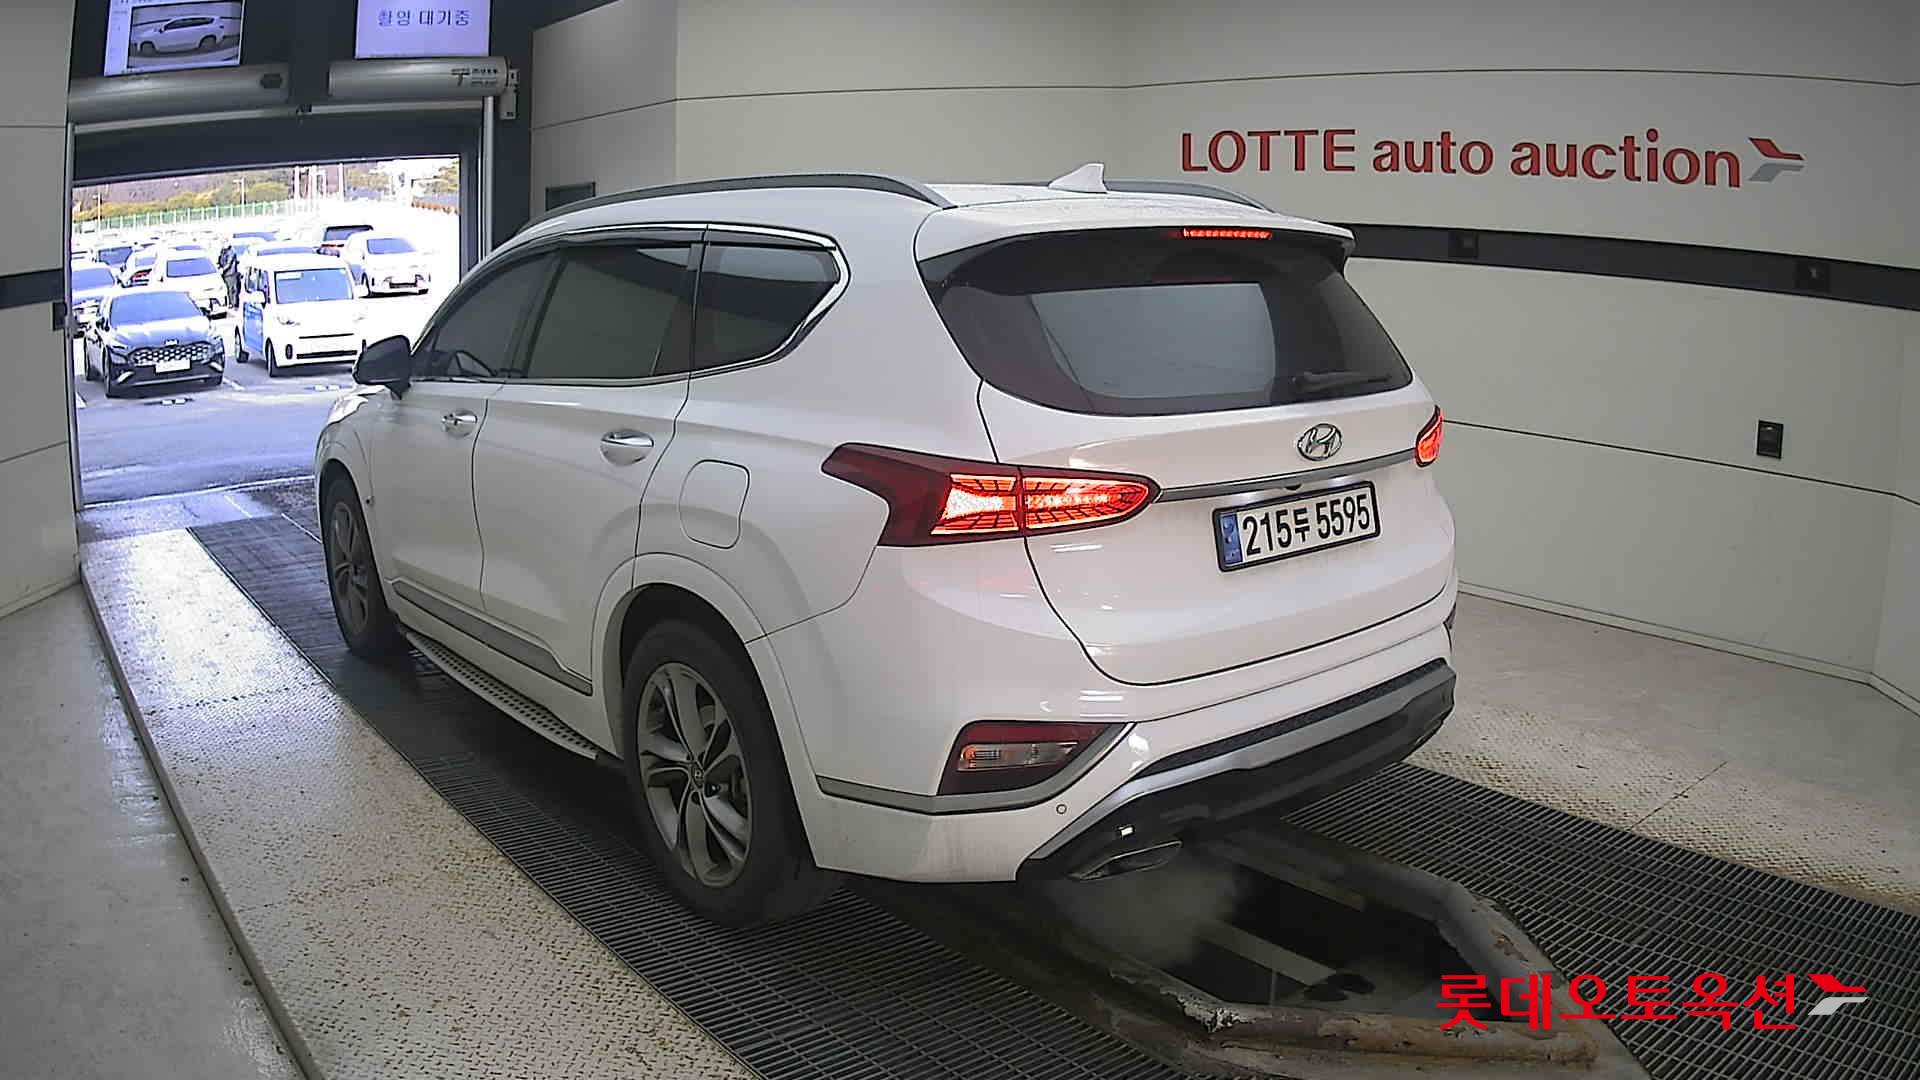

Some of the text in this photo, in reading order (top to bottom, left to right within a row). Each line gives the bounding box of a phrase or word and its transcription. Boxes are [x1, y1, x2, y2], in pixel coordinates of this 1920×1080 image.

[418, 9, 471, 27] 대기중
[1181, 129, 1741, 188] LOTTE auto auction
[1243, 494, 1370, 556] 215두 5595
